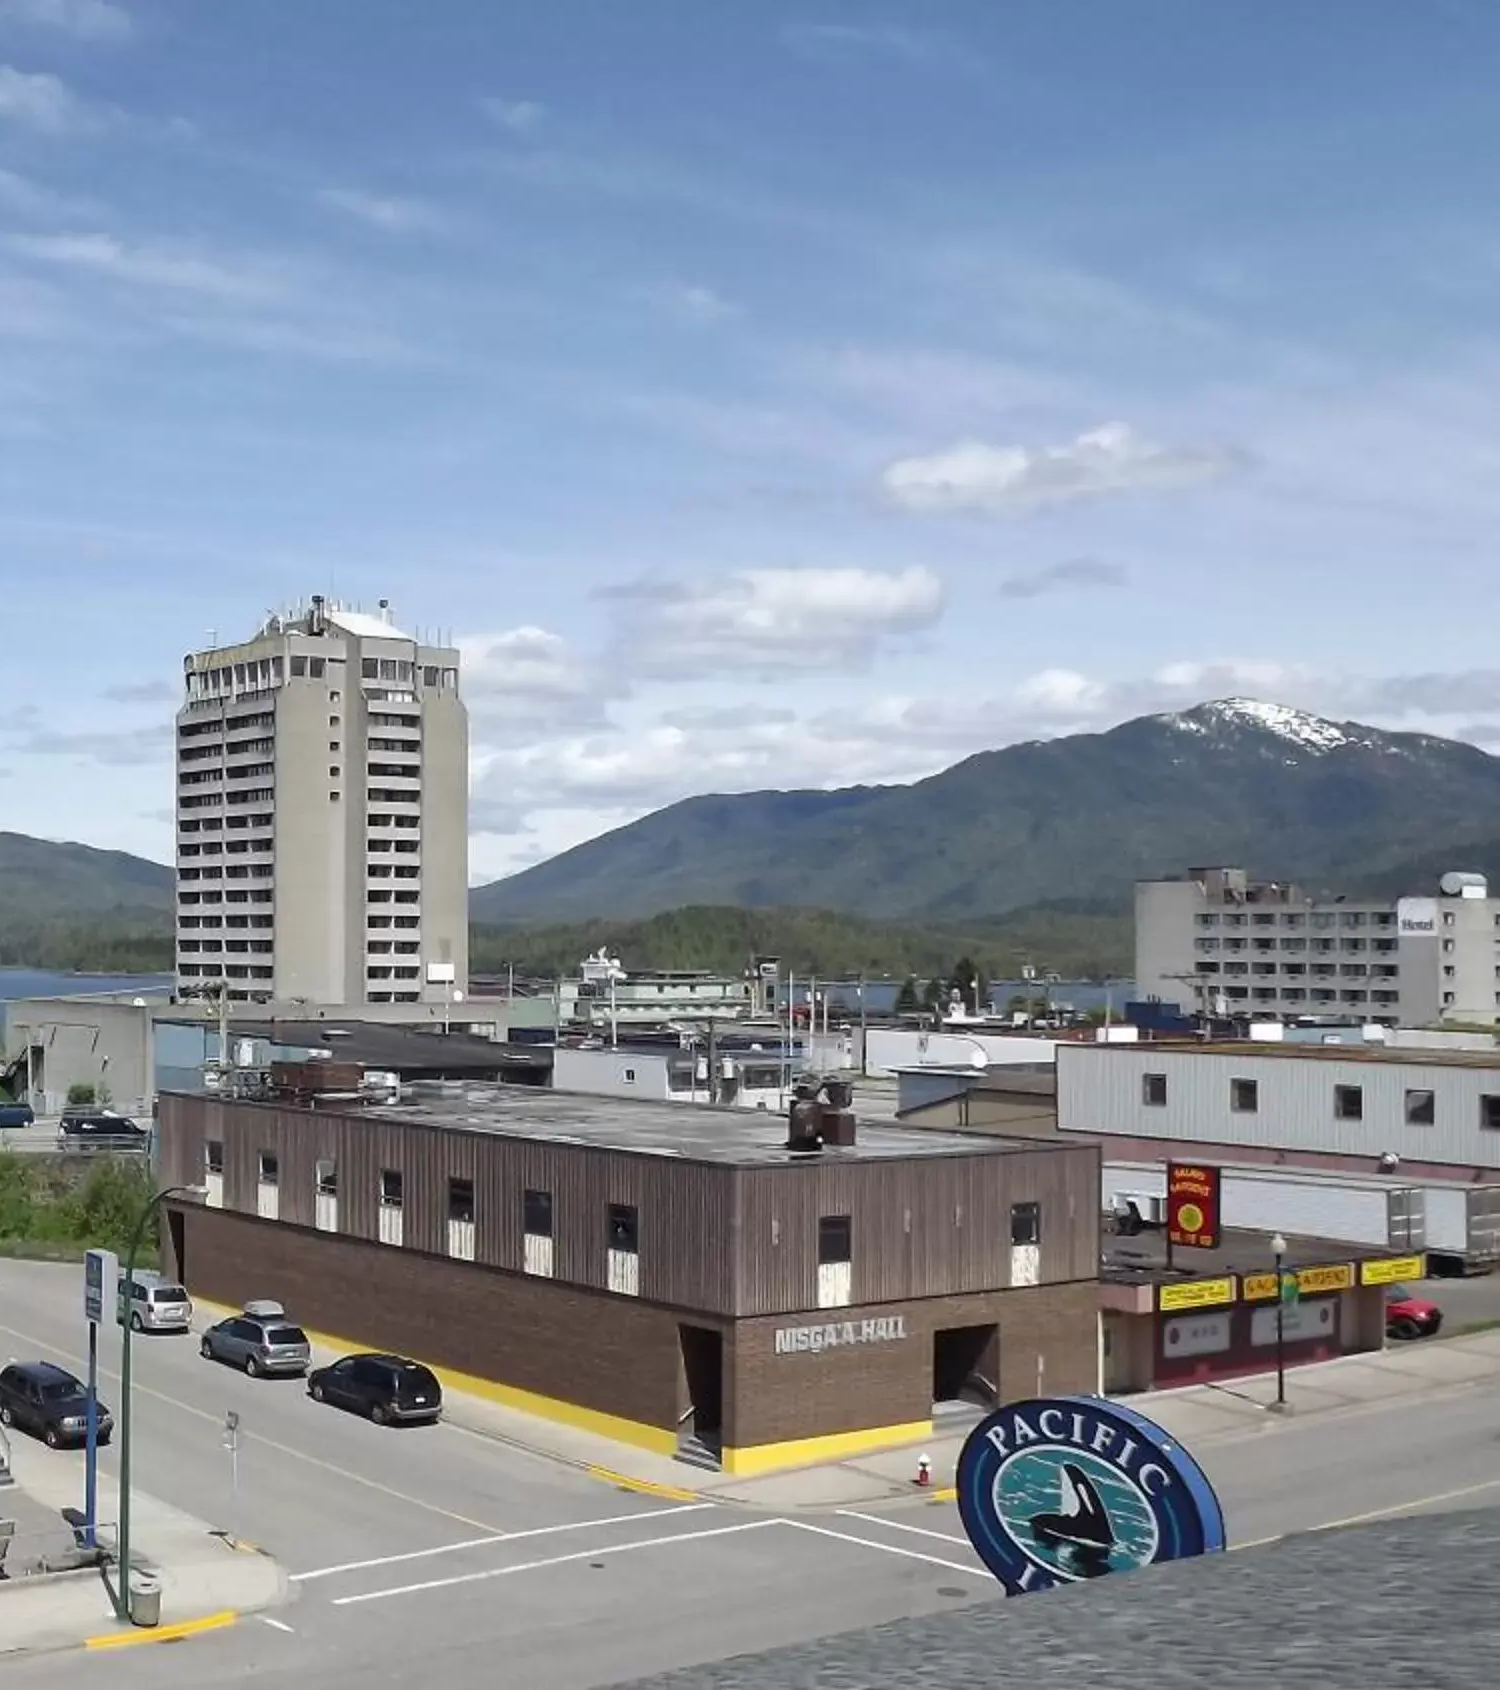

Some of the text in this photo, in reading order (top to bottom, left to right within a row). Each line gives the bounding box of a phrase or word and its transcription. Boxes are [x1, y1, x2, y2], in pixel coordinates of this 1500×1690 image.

[1402, 918, 1433, 930] Hotel
[861, 1315, 907, 1343] HALL
[985, 1409, 1172, 1497] PACIFIC
